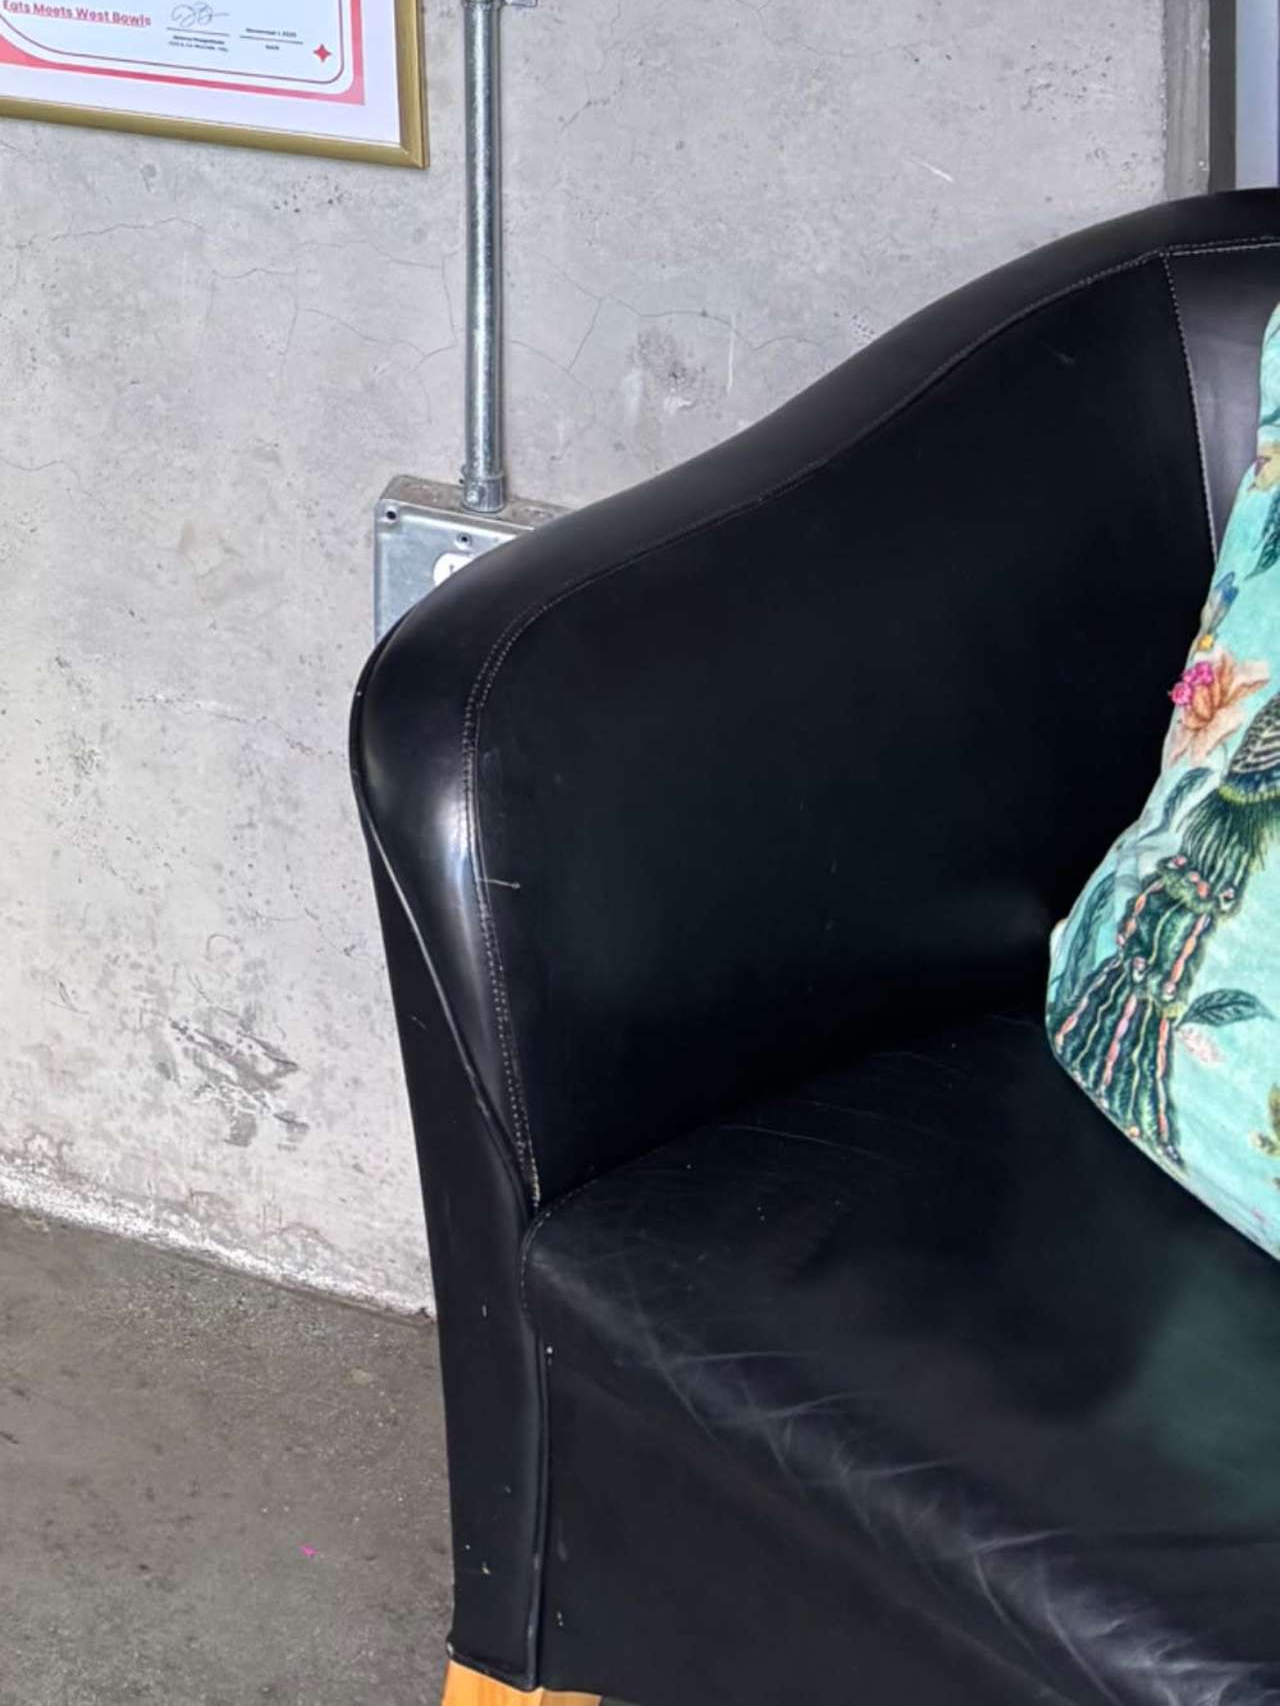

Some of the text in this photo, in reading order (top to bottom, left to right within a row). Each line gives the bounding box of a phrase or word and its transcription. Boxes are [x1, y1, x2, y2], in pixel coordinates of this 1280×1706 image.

[2, 0, 152, 27] Eats Meets West Bowls
